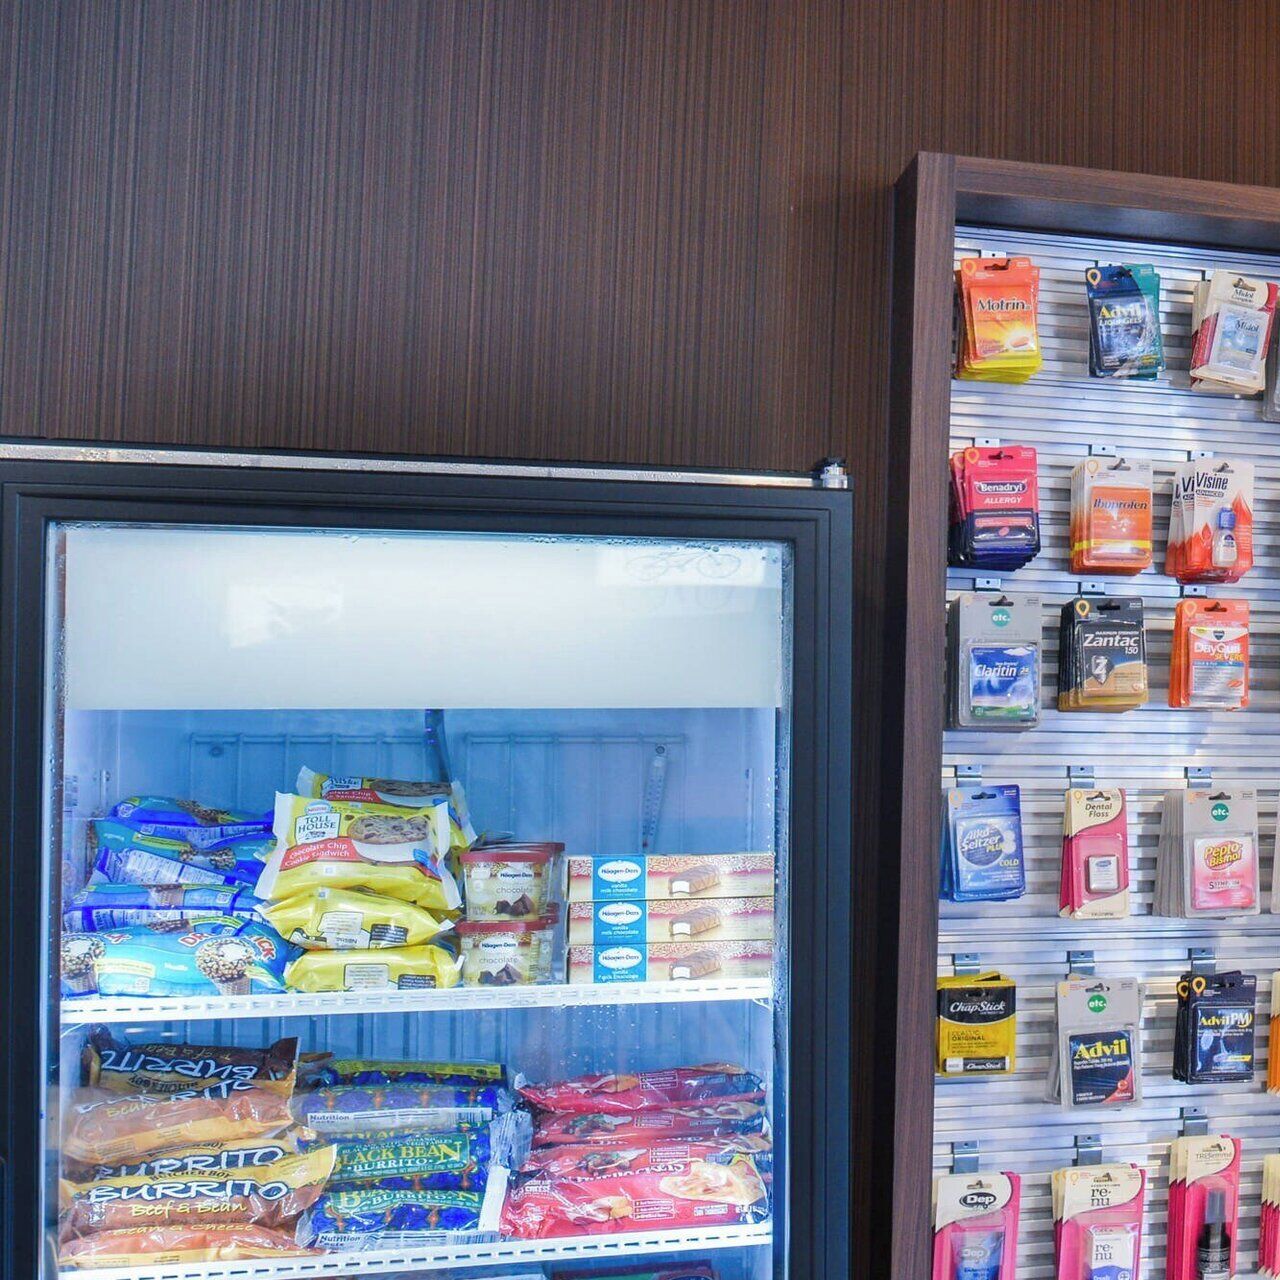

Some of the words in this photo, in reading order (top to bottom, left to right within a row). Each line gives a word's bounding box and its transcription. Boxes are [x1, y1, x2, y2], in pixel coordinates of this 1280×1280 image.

[976, 297, 1026, 312] Motrin
[1195, 470, 1229, 491] Visine
[980, 481, 1023, 494] Benadryl
[1083, 634, 1139, 648] Zantac
[1124, 646, 1138, 655] 150
[1194, 643, 1240, 655] DayQuil
[974, 664, 1017, 677] Claritin
[1084, 803, 1112, 811] Dental
[305, 816, 330, 824] TOLL
[1088, 810, 1109, 818] Floss
[298, 822, 336, 833] HOUSE
[327, 842, 347, 850] Chip
[960, 835, 1001, 852] Seltzer
[950, 1001, 1005, 1013] ChapStick
[1088, 1000, 1106, 1008] etc.
[1199, 1014, 1230, 1026] Advil
[1230, 1012, 1249, 1025] PM
[1073, 1038, 1127, 1059] Advil
[401, 1142, 462, 1161] BEAN
[89, 1180, 288, 1202] BURRITO
[965, 1194, 995, 1206] Dep
[131, 1201, 171, 1218] Beef
[197, 1202, 247, 1213] Bean
